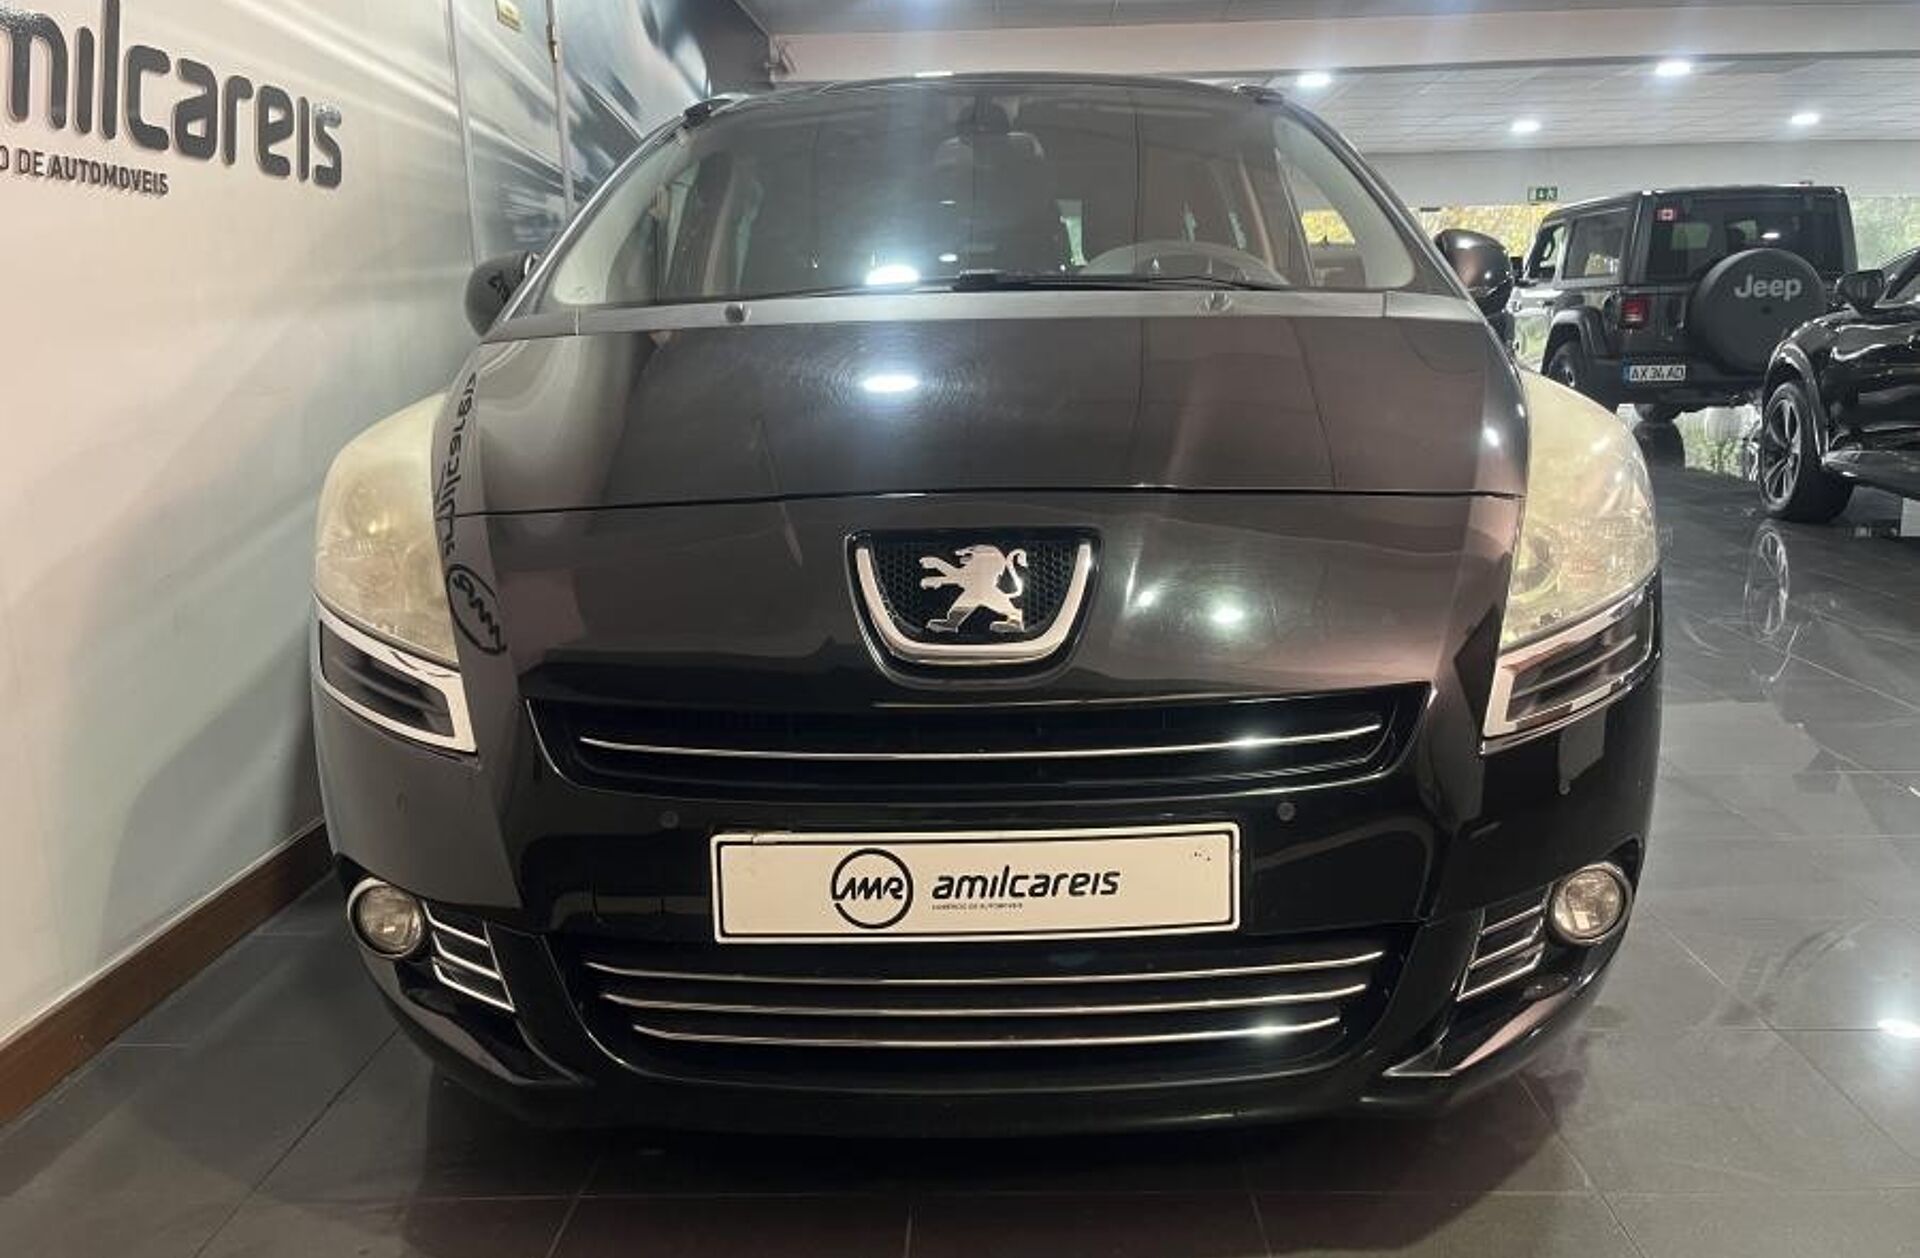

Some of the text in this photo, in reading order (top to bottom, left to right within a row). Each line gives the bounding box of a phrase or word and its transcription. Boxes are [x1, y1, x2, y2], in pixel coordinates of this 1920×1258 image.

[18, 148, 44, 176] DE
[48, 154, 169, 195] AUTOMOVEIS
[1734, 273, 1802, 301] Jeep
[931, 865, 1121, 900] amilcareis
